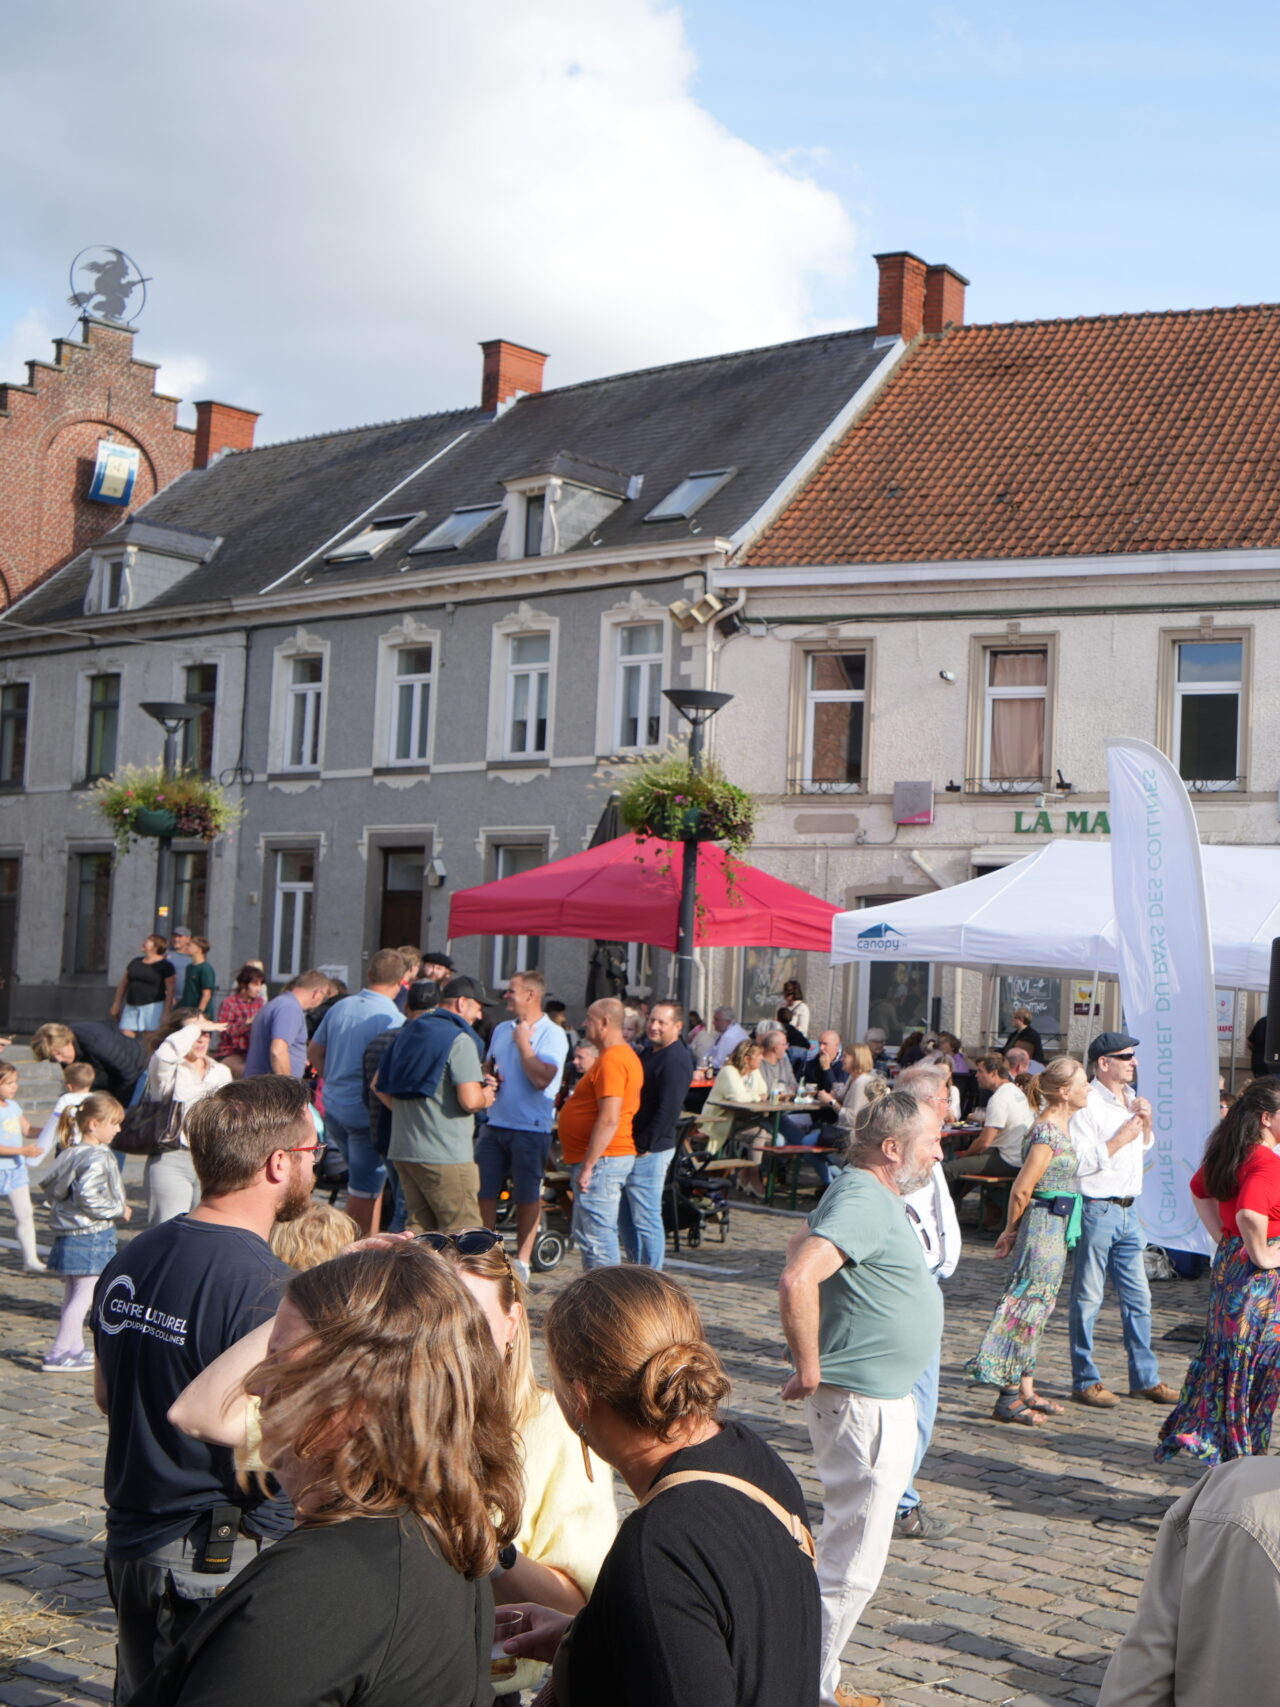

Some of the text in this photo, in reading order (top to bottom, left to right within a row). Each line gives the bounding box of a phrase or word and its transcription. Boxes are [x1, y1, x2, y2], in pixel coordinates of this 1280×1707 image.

[1014, 811, 1053, 833] LA
[857, 939, 899, 952] canopy
[145, 1307, 187, 1334] ULTUREL
